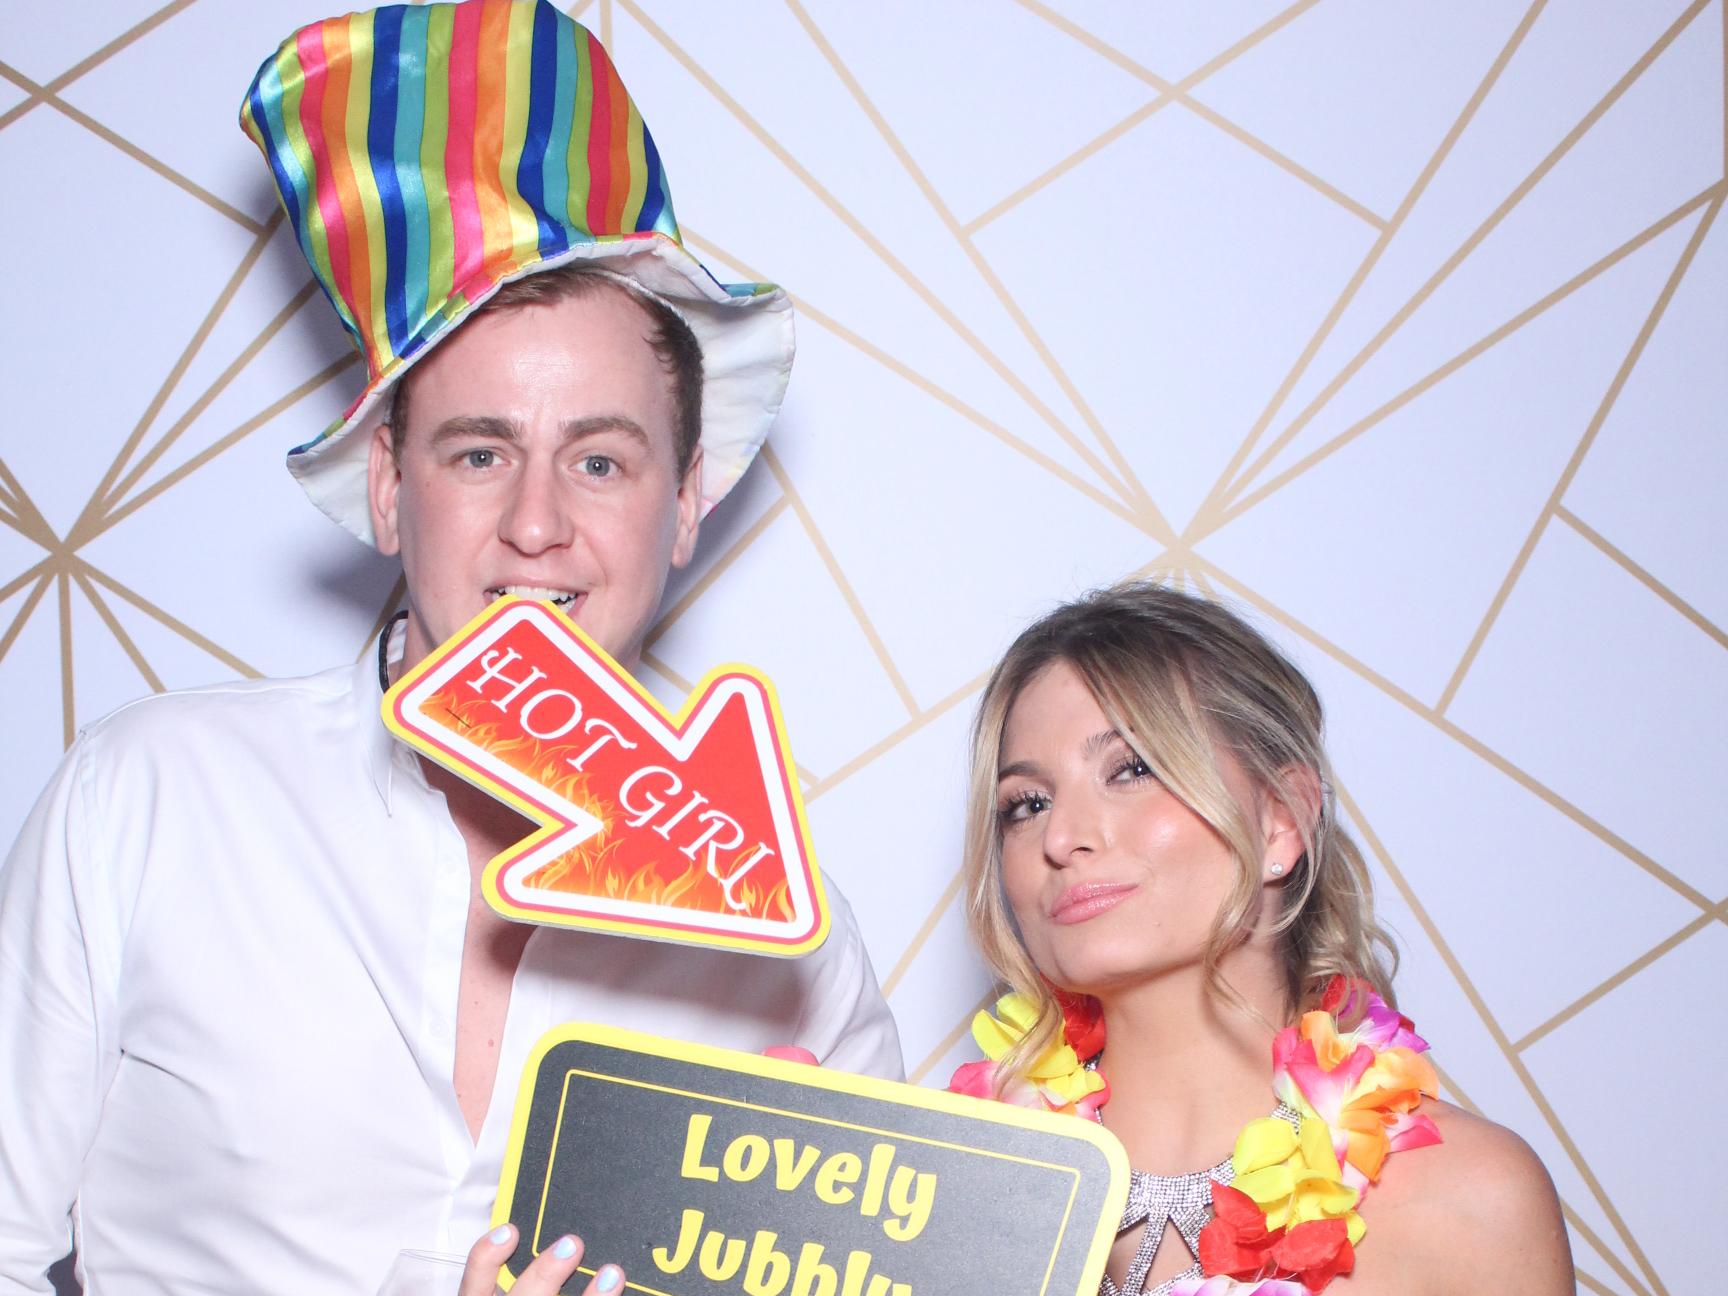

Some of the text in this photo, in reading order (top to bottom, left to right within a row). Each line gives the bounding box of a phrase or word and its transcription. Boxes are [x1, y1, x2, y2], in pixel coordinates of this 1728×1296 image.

[466, 647, 775, 911] HOT GIRL
[681, 1114, 937, 1242] Lovely
